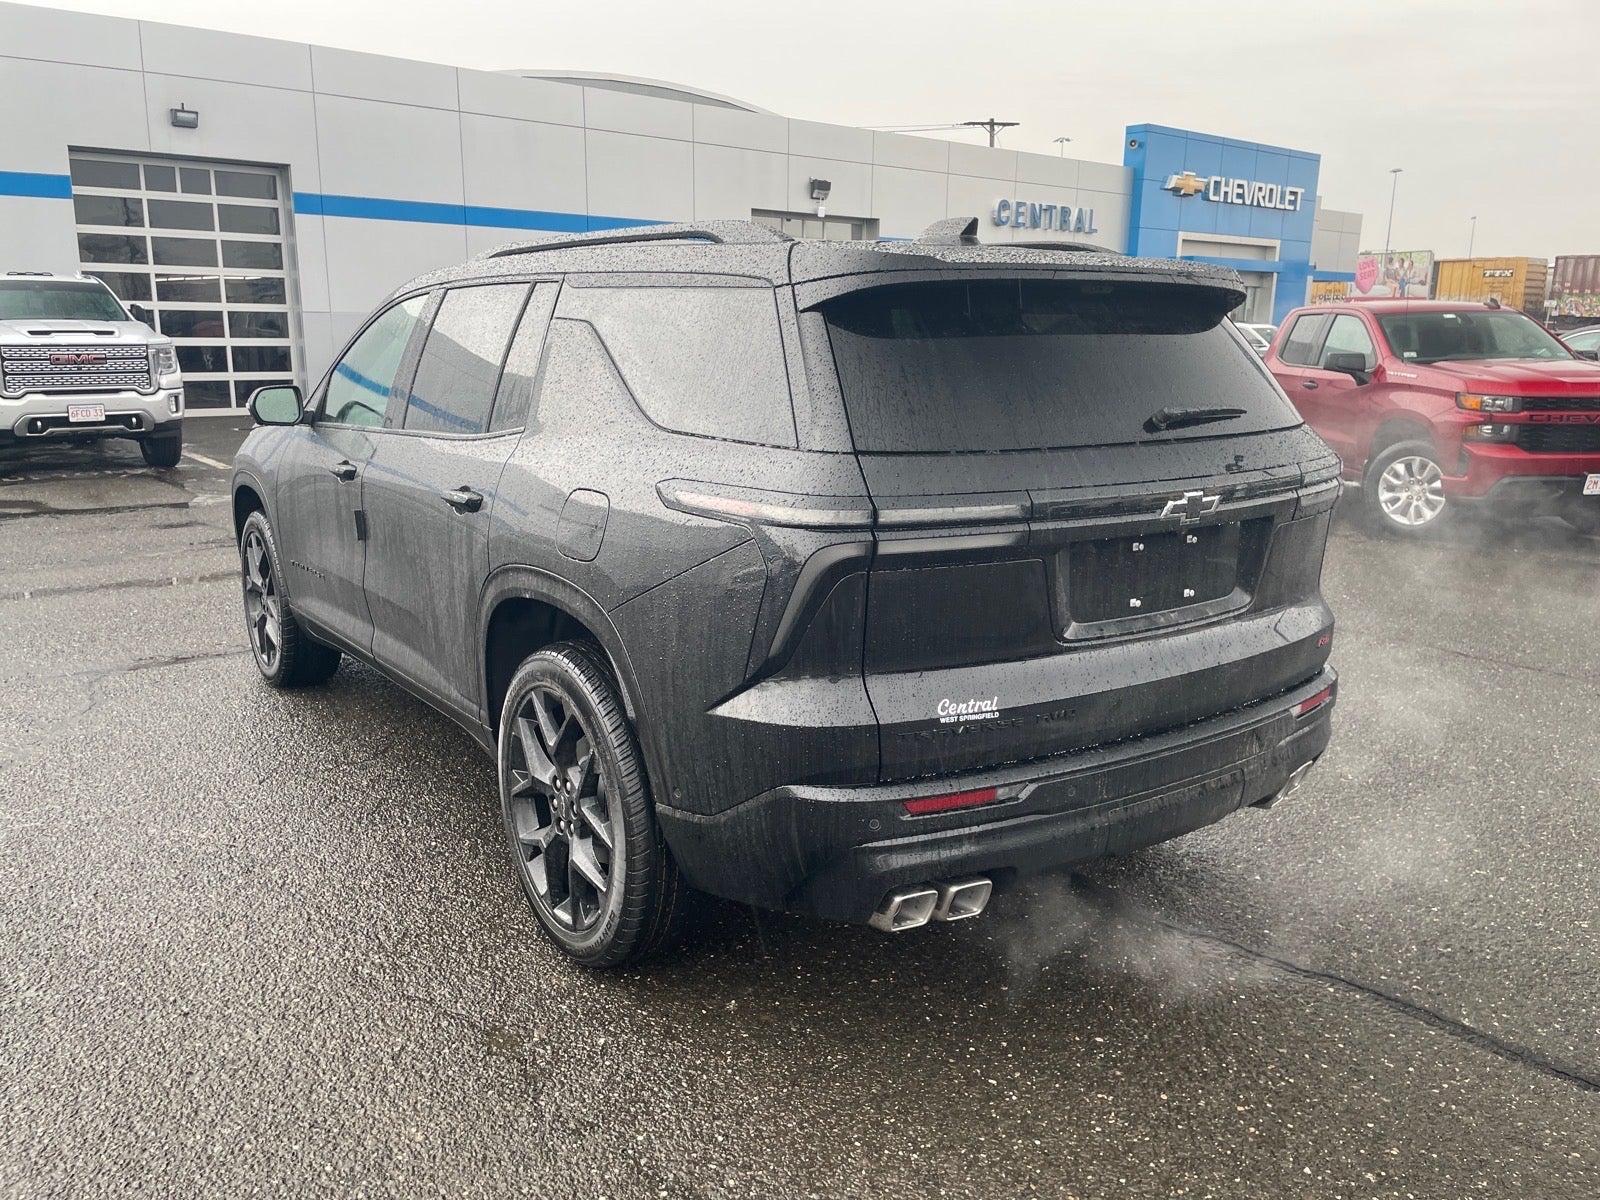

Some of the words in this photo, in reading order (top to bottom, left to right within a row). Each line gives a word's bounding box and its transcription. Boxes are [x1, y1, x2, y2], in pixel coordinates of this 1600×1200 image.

[1208, 175, 1305, 211] CHEVROLET
[996, 199, 1098, 234] CENTRAL
[1359, 259, 1376, 270] LOVE
[1484, 269, 1514, 277] TTX
[51, 354, 107, 365] GMC
[94, 409, 104, 417] 33
[937, 696, 998, 716] Central
[940, 715, 959, 723] WEST
[959, 711, 1000, 722] SPRINGFIELD
